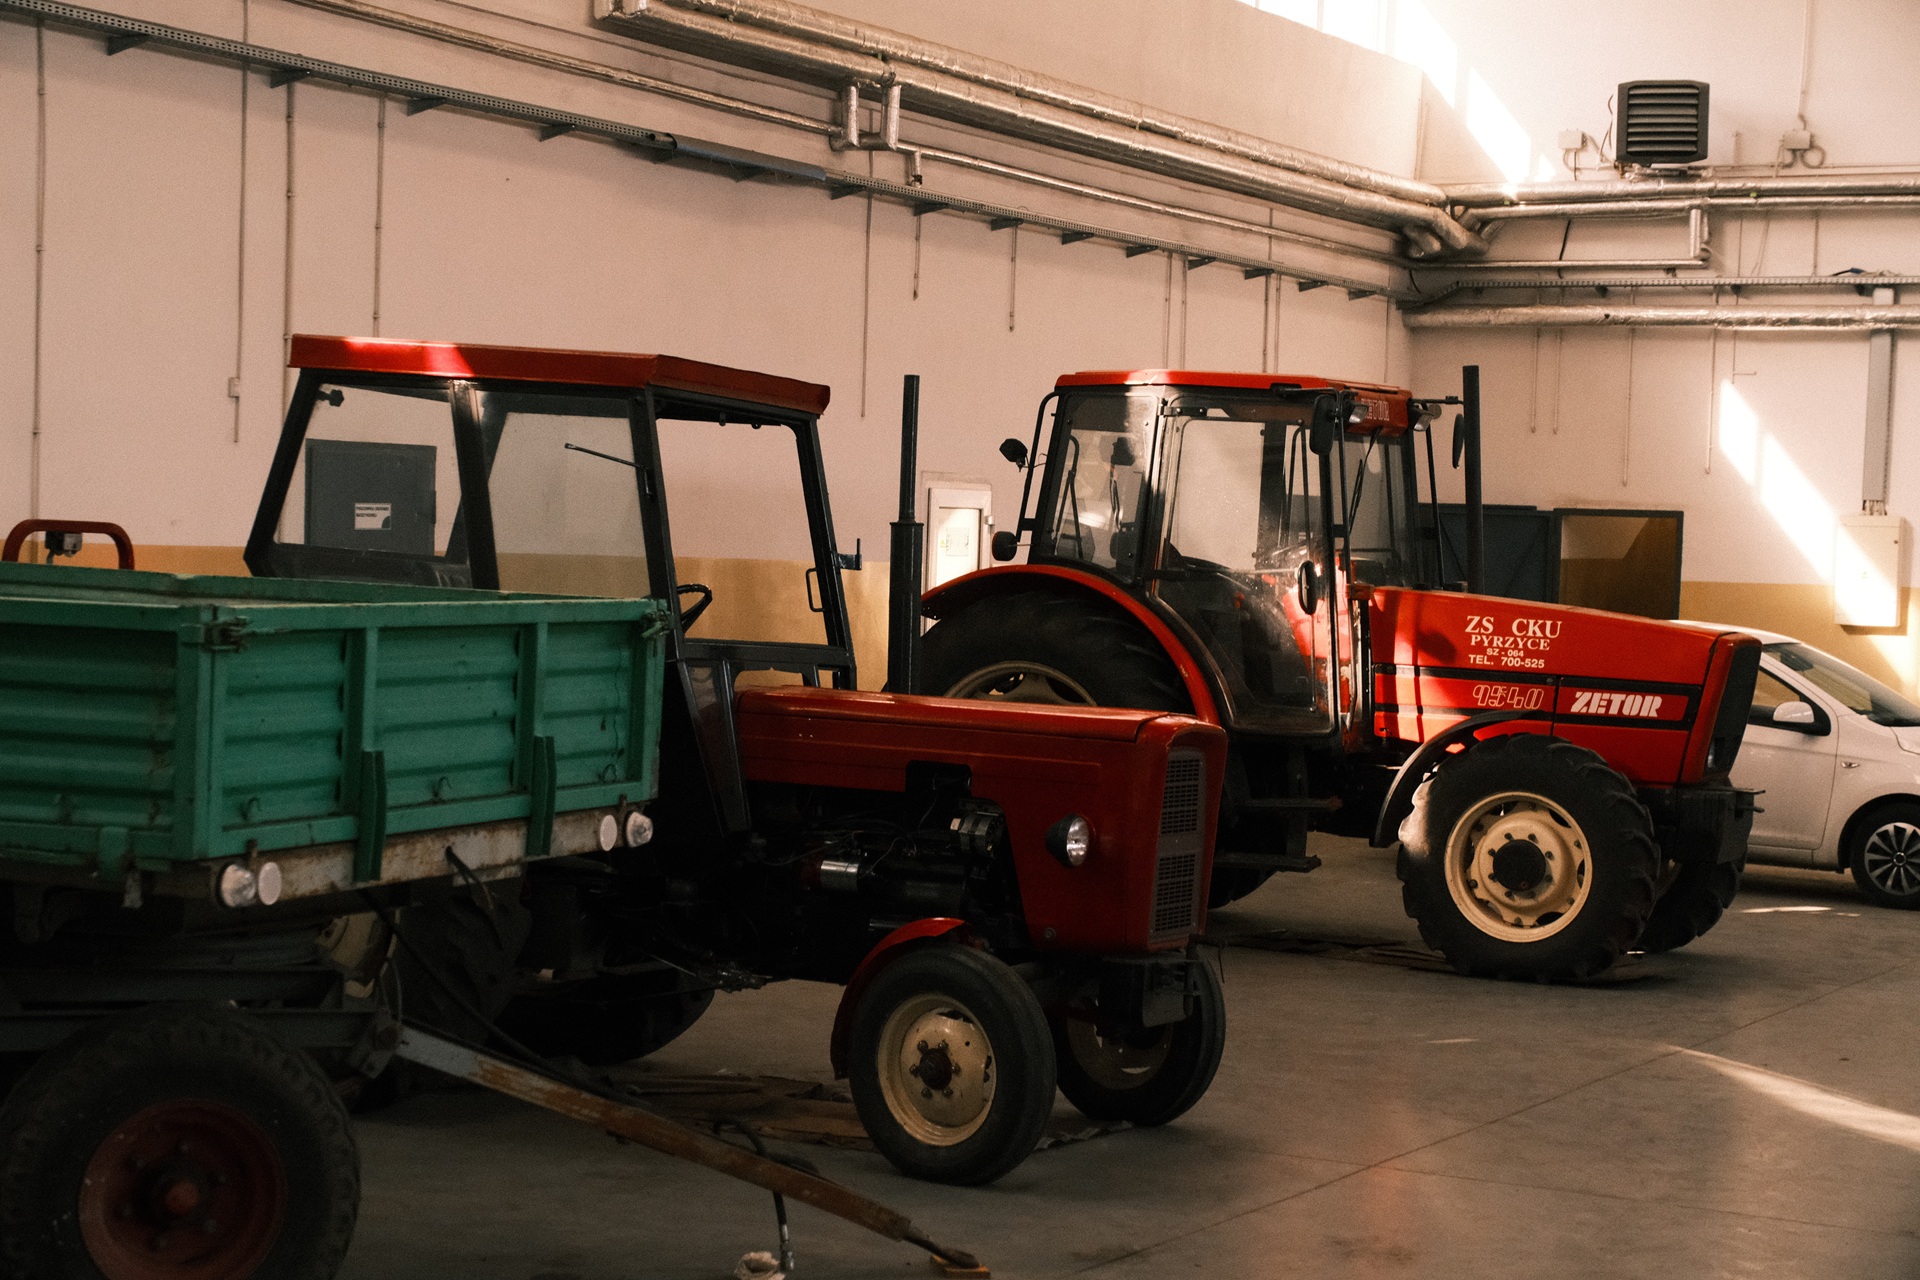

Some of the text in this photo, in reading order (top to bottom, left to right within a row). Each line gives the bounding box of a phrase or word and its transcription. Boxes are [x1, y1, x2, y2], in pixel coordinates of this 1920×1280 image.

[1465, 615, 1562, 639] ZS CKU
[1470, 634, 1550, 651] PYRZYCE
[1468, 654, 1545, 668] TEL. 700-525
[1570, 691, 1663, 718] ZETOR
